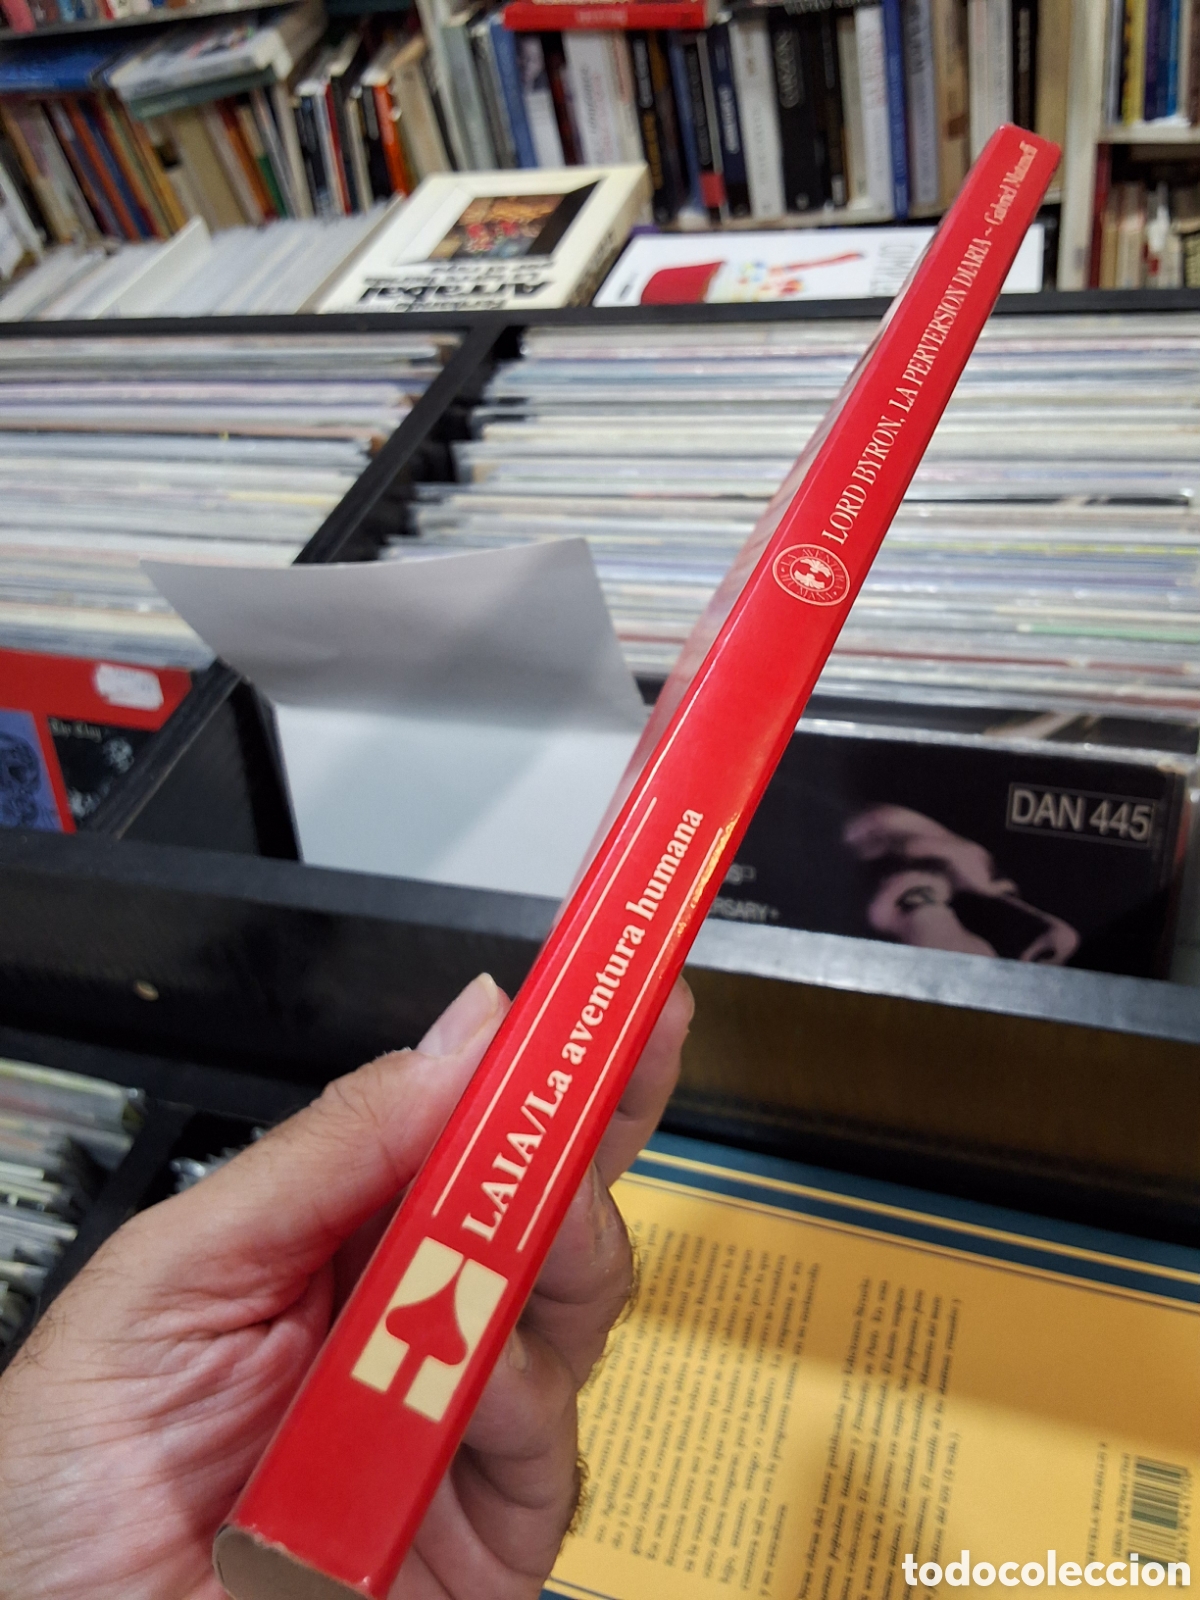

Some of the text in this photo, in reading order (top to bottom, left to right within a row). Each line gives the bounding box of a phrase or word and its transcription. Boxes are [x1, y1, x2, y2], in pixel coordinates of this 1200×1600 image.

[952, 237, 992, 288] DIARIA
[902, 284, 968, 387] PERVERSION
[888, 387, 919, 413] LA
[852, 415, 906, 486] BYRON,
[821, 484, 867, 545] LORD
[1010, 788, 1151, 842] DAN 445
[461, 808, 704, 1243] LAIA/La aventura humana
